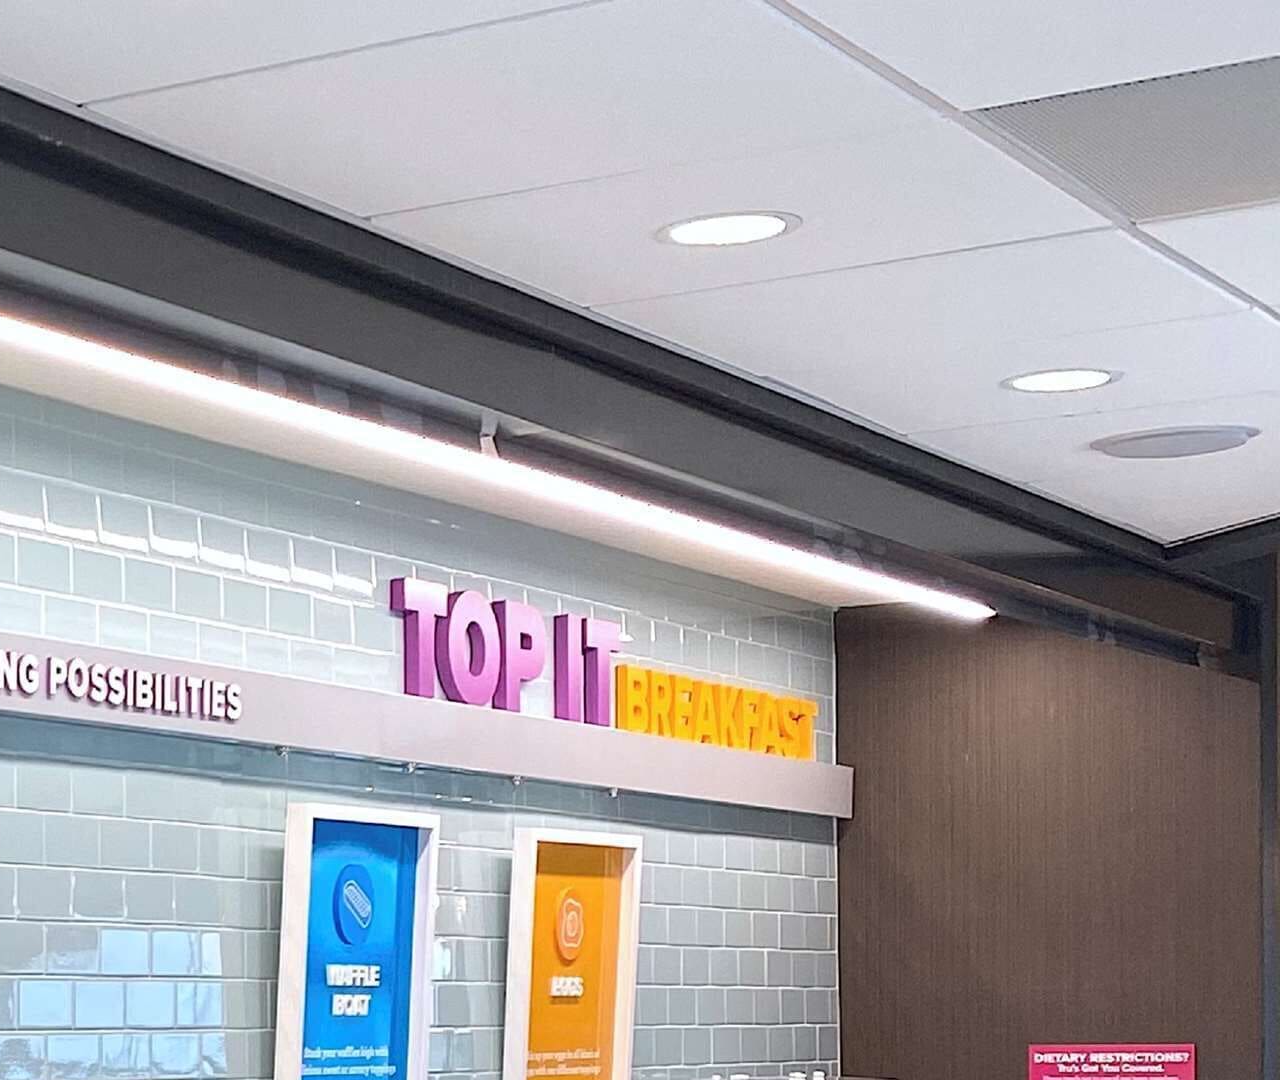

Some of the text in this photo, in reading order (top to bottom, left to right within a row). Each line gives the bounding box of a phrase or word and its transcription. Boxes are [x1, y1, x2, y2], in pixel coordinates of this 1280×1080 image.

[389, 576, 621, 727] TOP IT
[48, 656, 243, 722] POSSIBILITIES
[615, 664, 817, 761] BREAKFAST
[325, 964, 381, 987] WAFFLE
[1033, 1052, 1190, 1064] DIETARY RESTRICTIONS?
